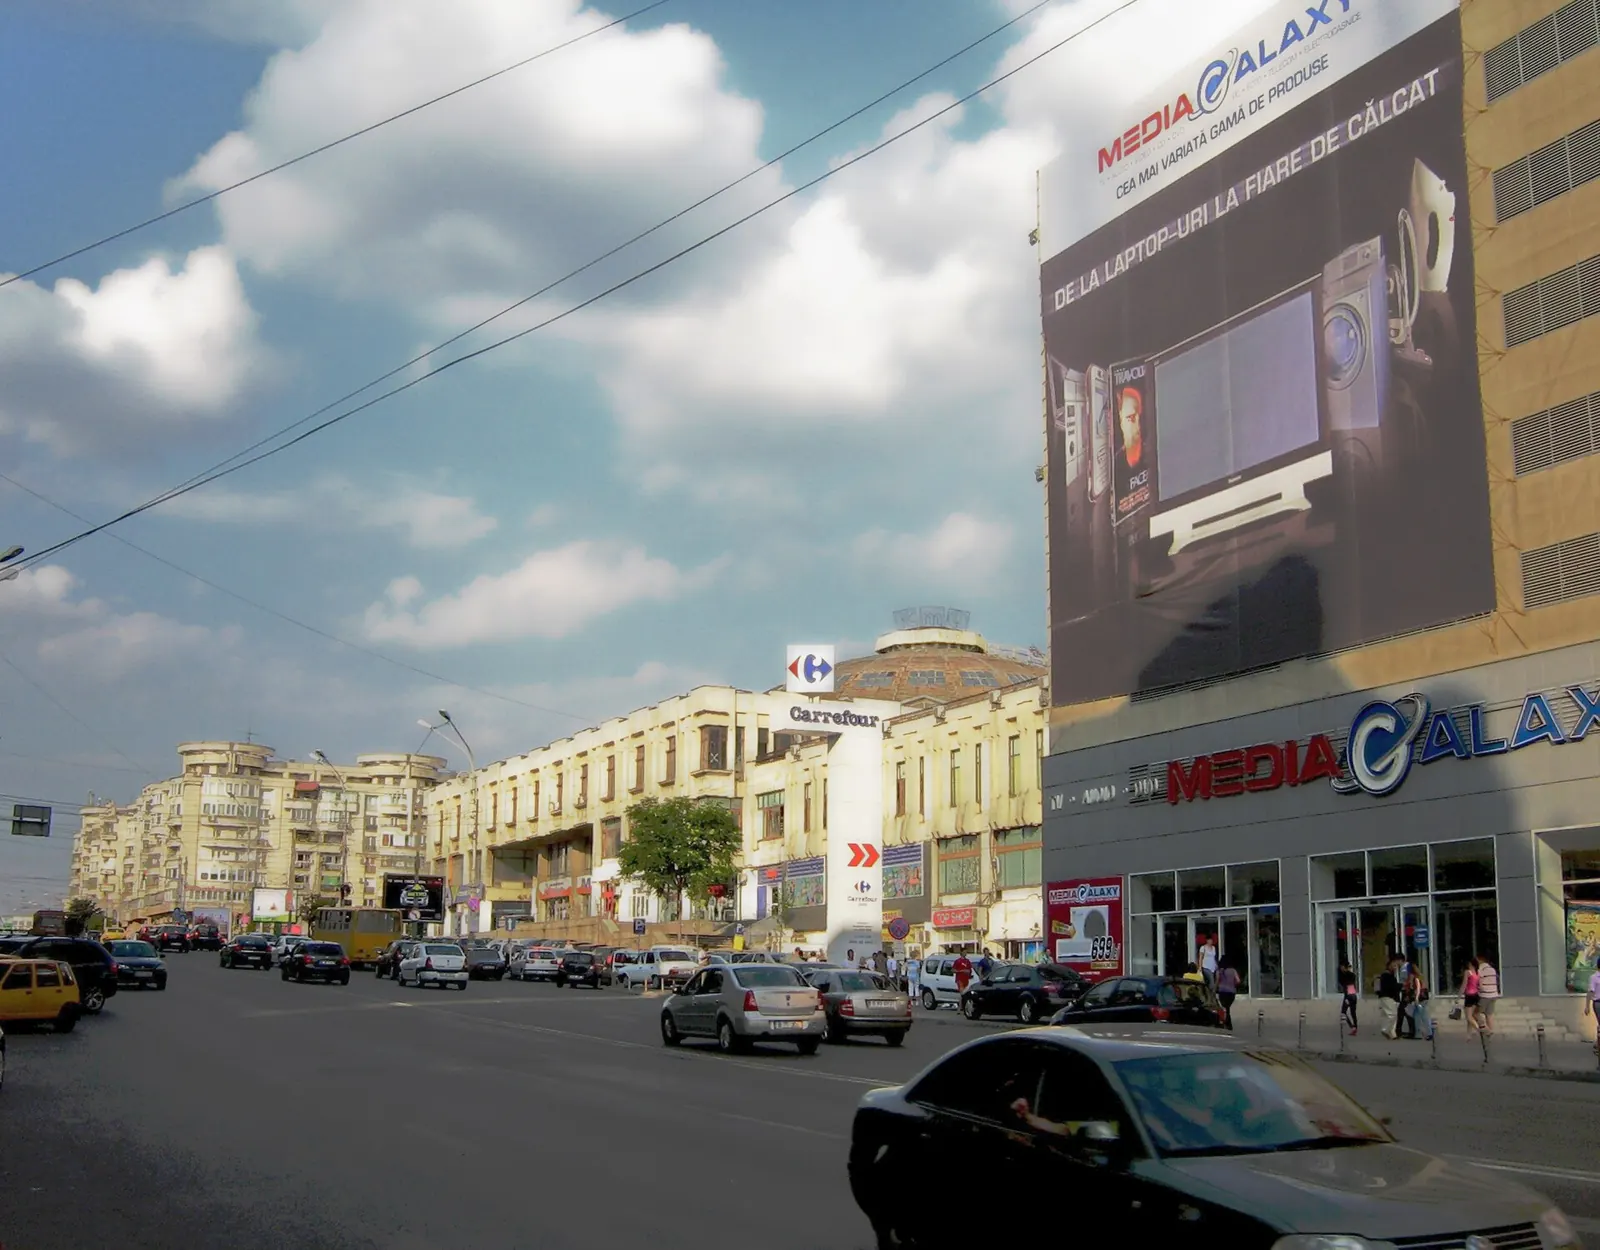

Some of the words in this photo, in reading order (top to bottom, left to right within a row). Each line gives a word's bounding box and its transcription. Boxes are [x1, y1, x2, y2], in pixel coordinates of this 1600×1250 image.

[1098, 93, 1194, 174] MEDIA
[1116, 178, 1136, 200] CEA
[1138, 163, 1159, 185] MAI
[1161, 130, 1208, 170] VARIATĂ
[1210, 104, 1246, 140] GAMĂ
[1249, 94, 1265, 116] DE
[1268, 54, 1330, 103] PRODUSE
[1054, 281, 1075, 312] DE
[1080, 268, 1100, 296] LA
[1105, 203, 1209, 282] LAPTOP-URI
[1215, 187, 1240, 219] LA
[1245, 147, 1303, 201] FIARE
[1310, 127, 1340, 163] DE
[1347, 67, 1440, 142] CĂLCAT
[789, 705, 880, 728] Carrefour
[1166, 733, 1344, 805] MEDIA
[936, 912, 950, 924] TOP
[951, 910, 971, 922] SHOP
[1050, 891, 1077, 901] MEDIA
[1076, 884, 1119, 904] GALAXY
[1091, 936, 1113, 960] 699
